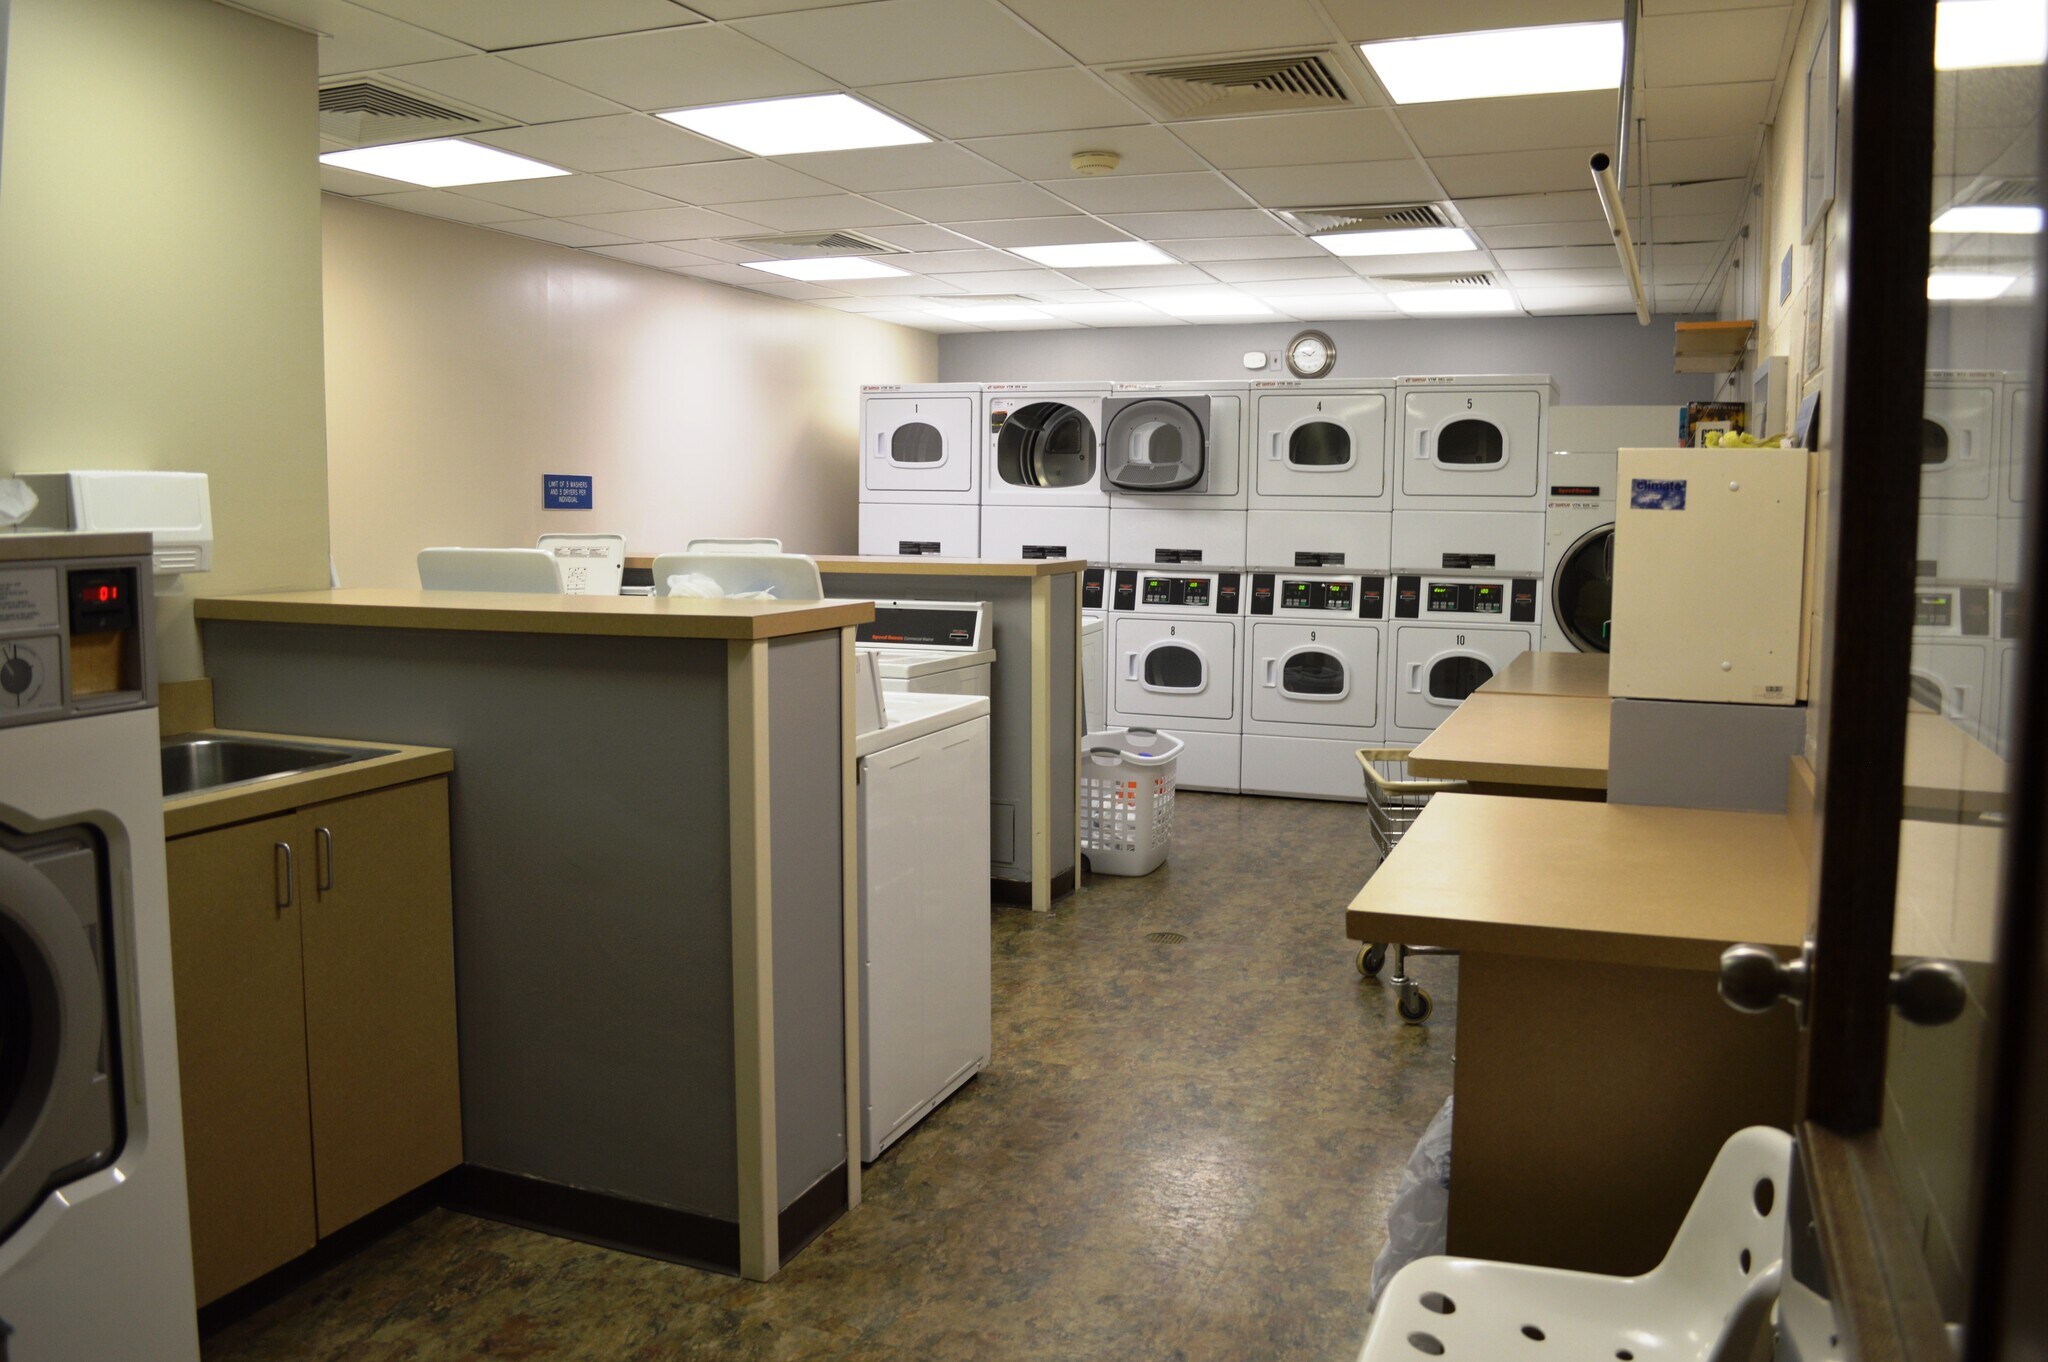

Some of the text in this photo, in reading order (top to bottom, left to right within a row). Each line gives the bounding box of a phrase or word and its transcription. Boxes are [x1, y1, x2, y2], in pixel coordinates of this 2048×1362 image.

[915, 403, 918, 414] 1
[1316, 401, 1322, 412] 4
[1467, 398, 1473, 410] 5
[1170, 625, 1176, 636] 8
[1310, 631, 1316, 642] 9
[1456, 634, 1465, 646] 10
